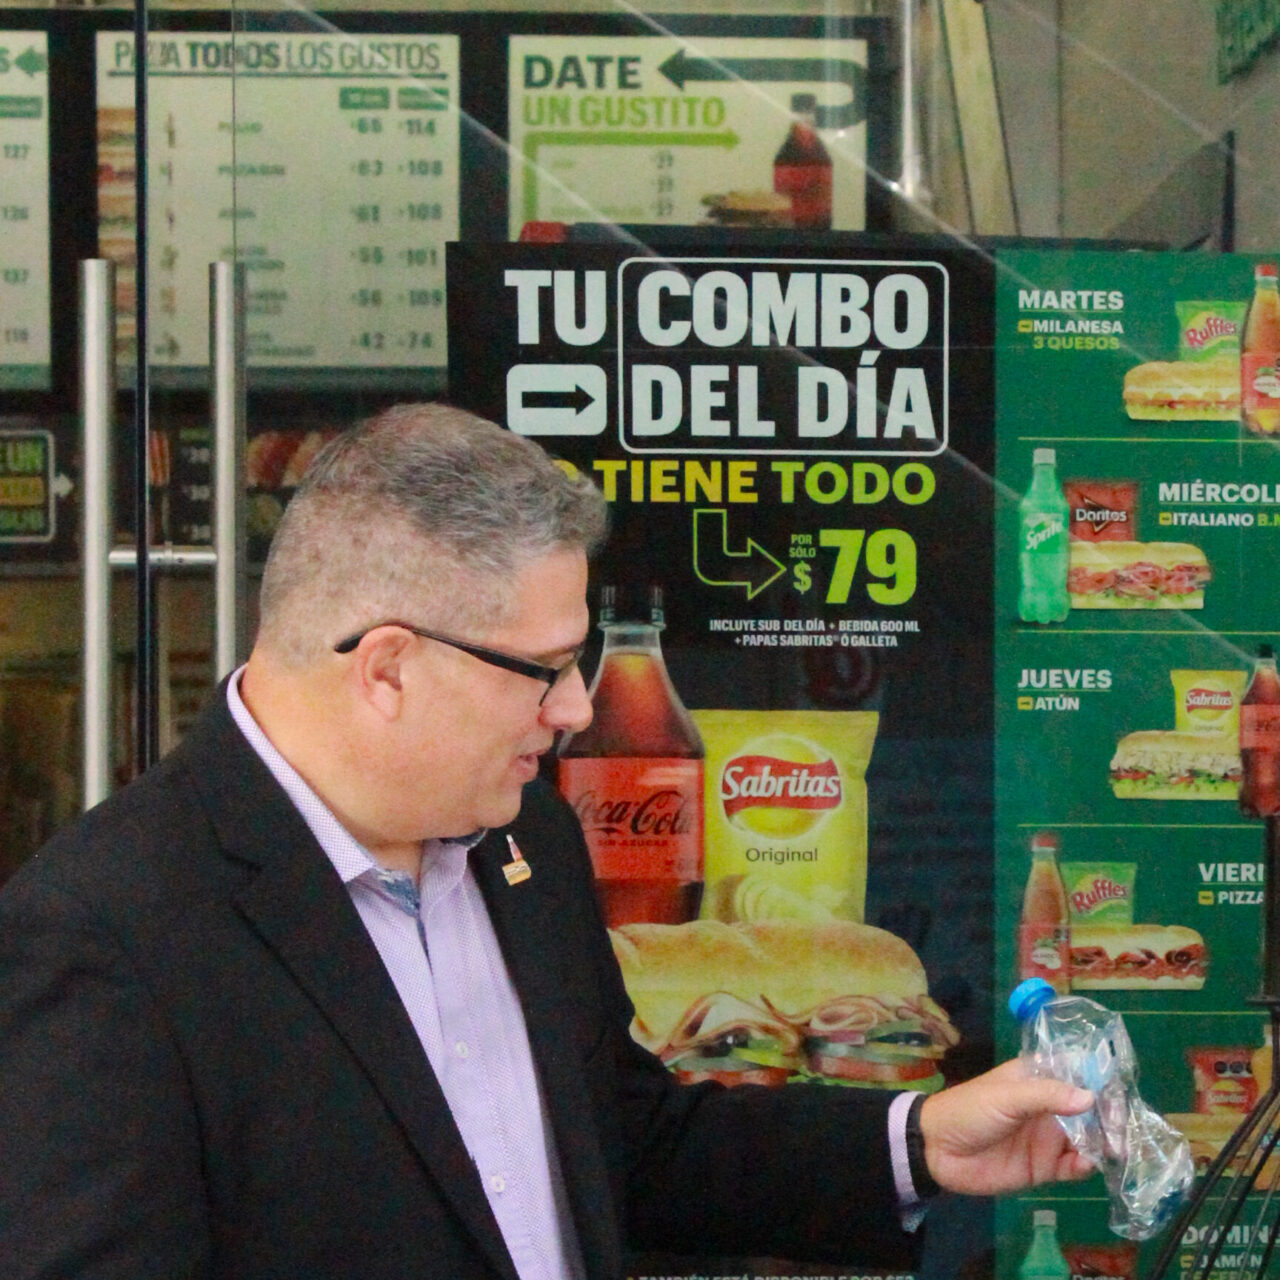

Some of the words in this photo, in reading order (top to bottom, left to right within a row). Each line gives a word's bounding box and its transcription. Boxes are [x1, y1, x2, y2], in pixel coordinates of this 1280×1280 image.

[286, 41, 333, 69] LOS
[339, 41, 441, 70] GUSTOS
[523, 54, 642, 90] DATE
[523, 96, 570, 126] UN
[578, 96, 726, 127] GUSTITO
[504, 270, 607, 346] TU
[637, 269, 929, 349] COMBO
[1018, 289, 1124, 310] MARTES
[1033, 319, 1124, 334] MILANESA
[1186, 316, 1238, 348] Ruffles
[1033, 336, 1045, 350] 3
[1048, 336, 1120, 350] QUESOS
[631, 364, 776, 437] DEL
[798, 350, 937, 439] DÍA
[593, 459, 758, 503] TIENE
[771, 462, 936, 506] TODO
[1075, 508, 1127, 523] Doritos
[1172, 512, 1254, 527] ITALIANO
[791, 534, 813, 545] POR
[1025, 519, 1063, 550] Sprite
[709, 619, 756, 632] INCLUYE
[757, 619, 780, 632] SUB
[783, 619, 805, 632] DEL
[806, 616, 826, 632] DÍA
[838, 620, 880, 632] BEBIDA
[880, 620, 903, 632] 600
[904, 620, 921, 632] ML
[742, 634, 778, 647] PAPAS
[850, 635, 898, 647] GALLETA
[1018, 668, 1112, 689] JUEVES
[1034, 694, 1080, 711] ATÚN
[1186, 691, 1233, 706] Sabritas
[720, 765, 841, 800] Sabritas
[745, 848, 818, 865] Original
[1071, 879, 1127, 914] Ruffles
[1218, 890, 1264, 905] PIZZA
